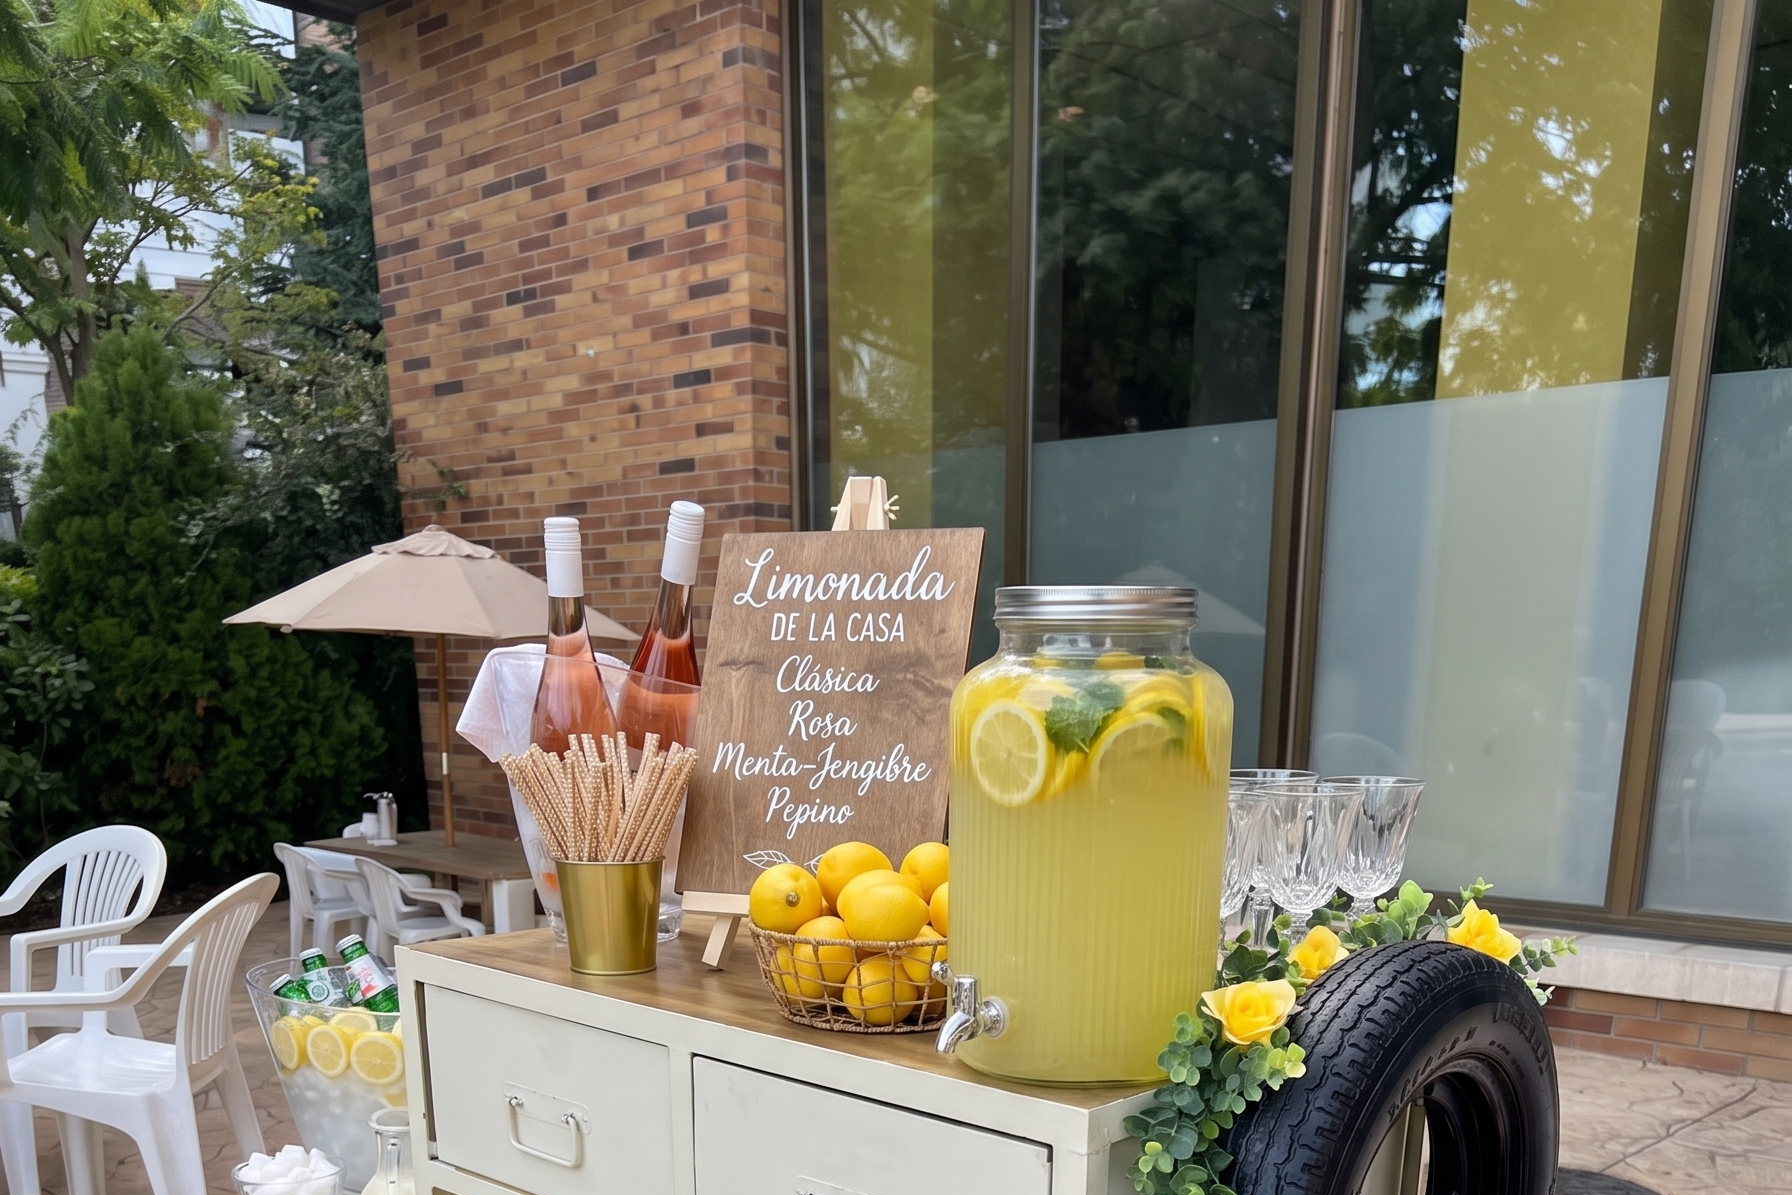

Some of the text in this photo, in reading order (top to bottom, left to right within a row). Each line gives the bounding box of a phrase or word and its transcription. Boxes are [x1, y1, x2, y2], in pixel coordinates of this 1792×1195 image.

[732, 545, 956, 608] Limonada
[770, 612, 905, 643] DE LA CASA
[776, 654, 880, 694] Clásica
[787, 699, 858, 741] Rosa
[712, 741, 932, 796] Menta-Jengibre
[765, 785, 855, 840] Pepino
